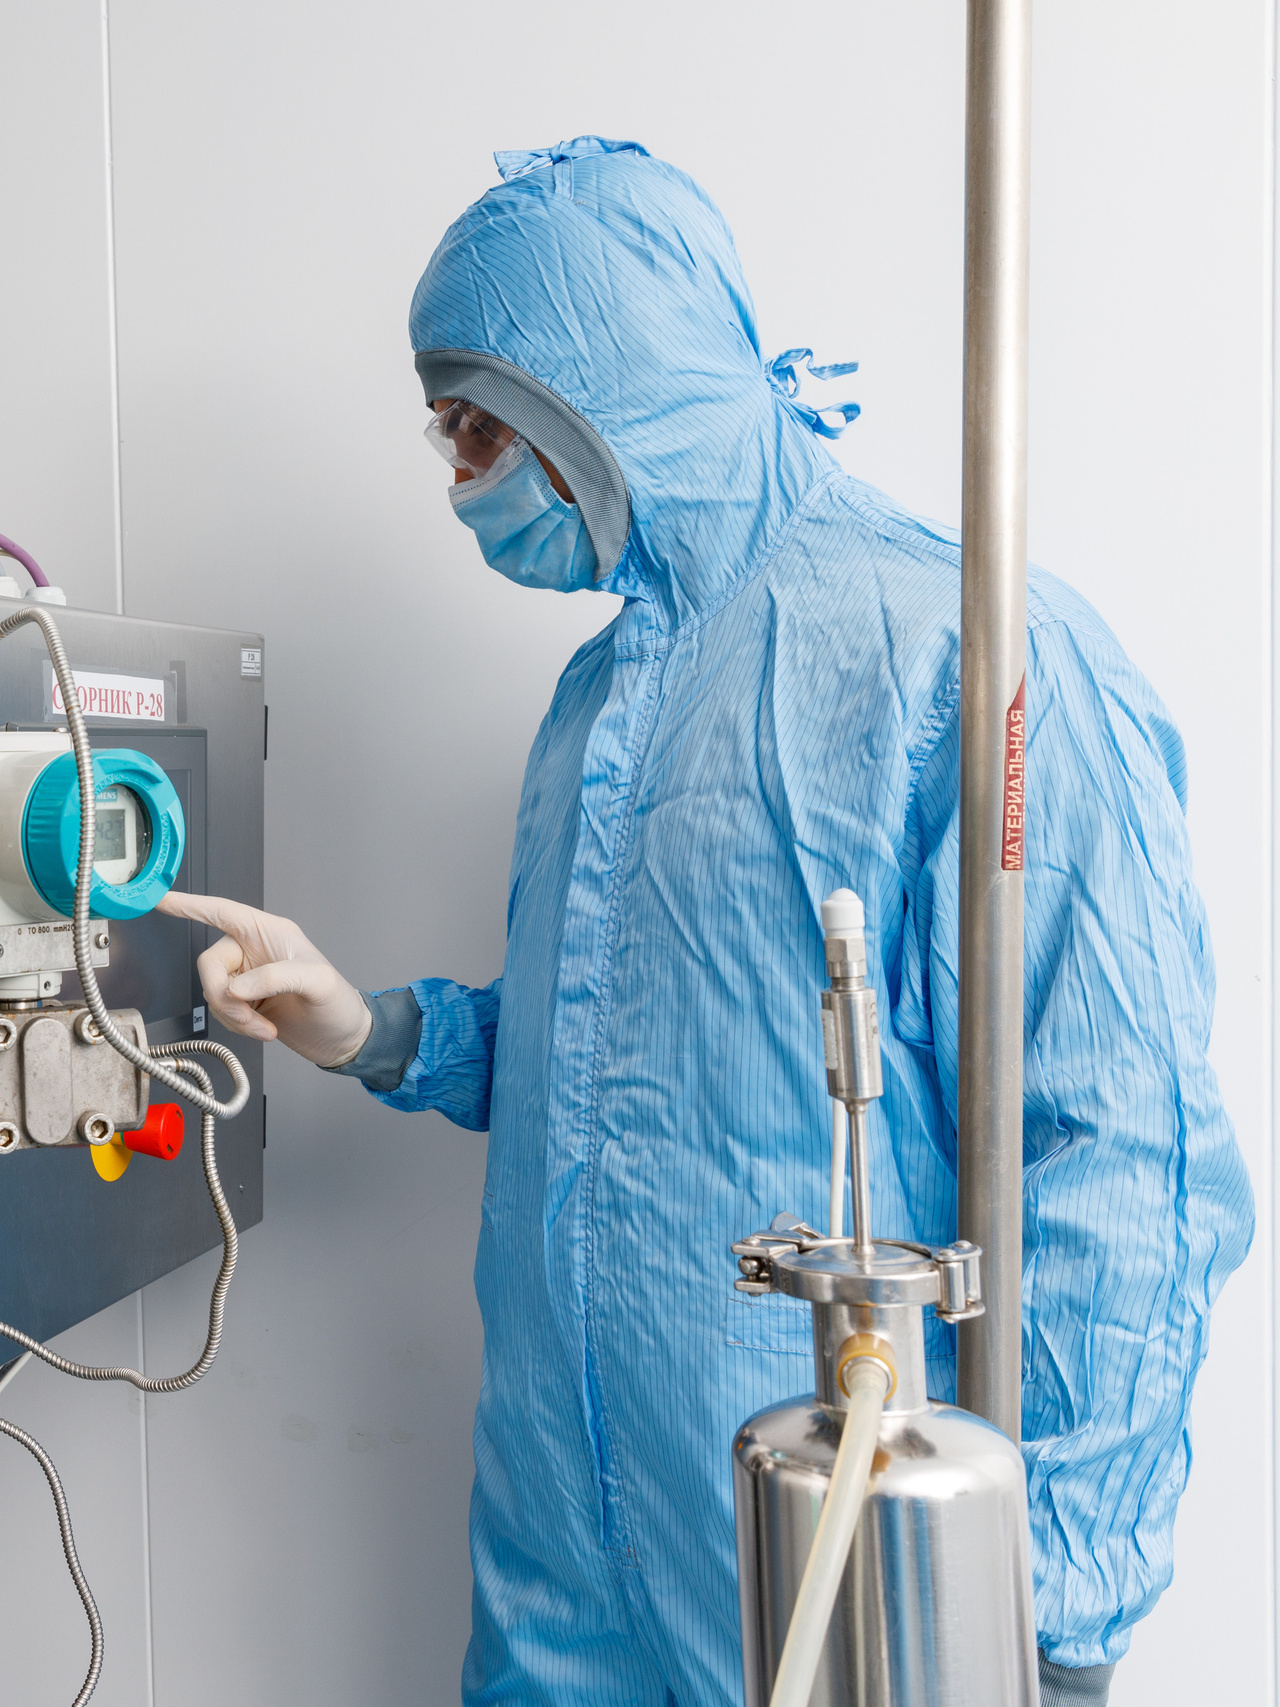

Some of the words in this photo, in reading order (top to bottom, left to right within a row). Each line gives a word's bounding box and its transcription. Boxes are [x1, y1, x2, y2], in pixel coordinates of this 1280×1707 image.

[52, 683, 132, 715] СОРНИК
[135, 691, 163, 718] Р-28
[96, 791, 117, 800] MENS
[1005, 709, 1024, 870] МАТЕРИАЛЬНАЯ
[27, 926, 37, 935] TO
[37, 925, 50, 934] 800
